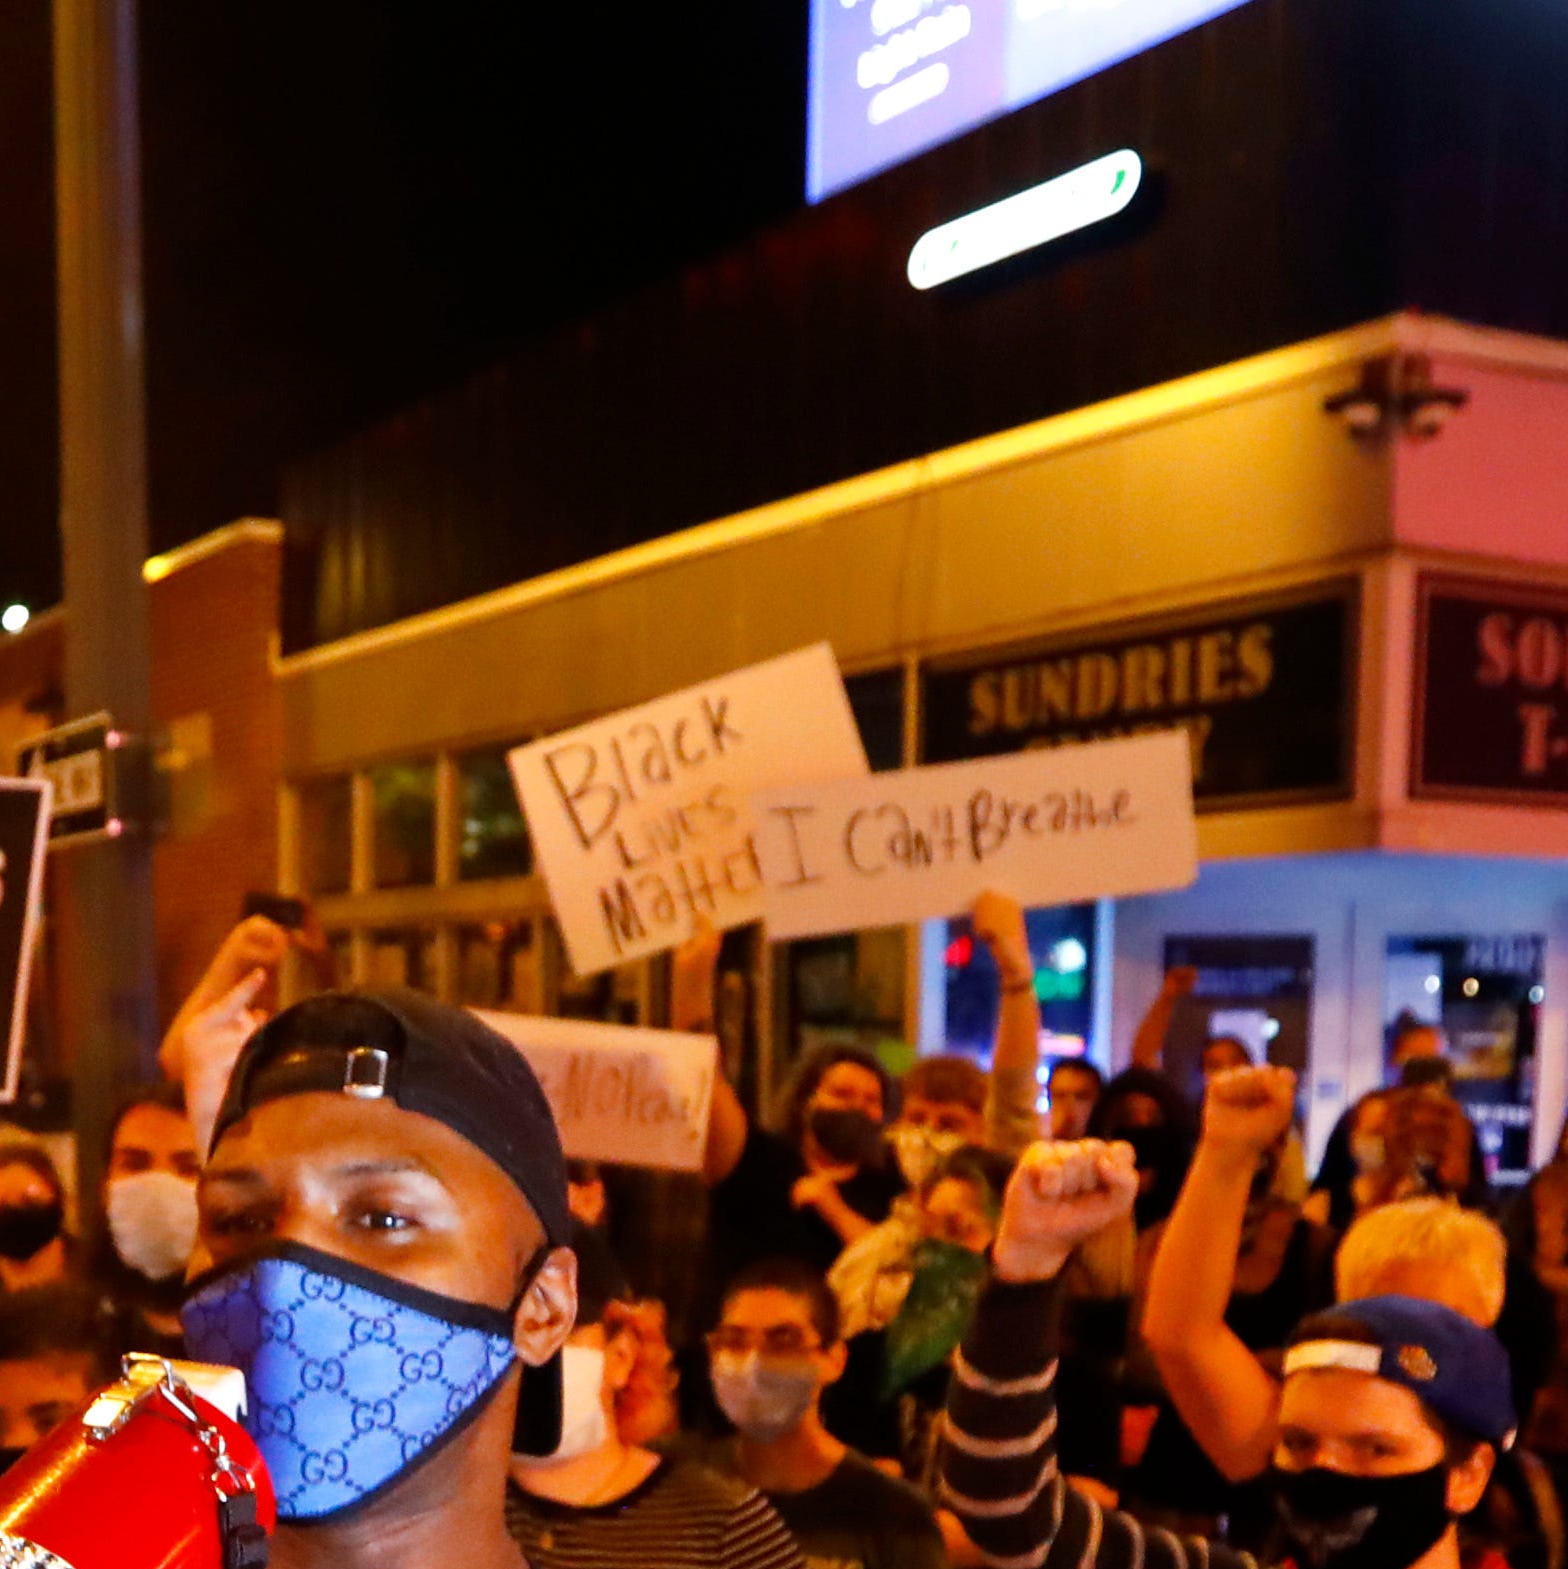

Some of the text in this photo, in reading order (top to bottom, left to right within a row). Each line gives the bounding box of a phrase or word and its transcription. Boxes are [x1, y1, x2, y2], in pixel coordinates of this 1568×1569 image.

[969, 622, 1275, 738] SUNDRIES
[543, 695, 743, 851] Black
[767, 804, 819, 889] I
[967, 787, 1135, 864] Breathe
